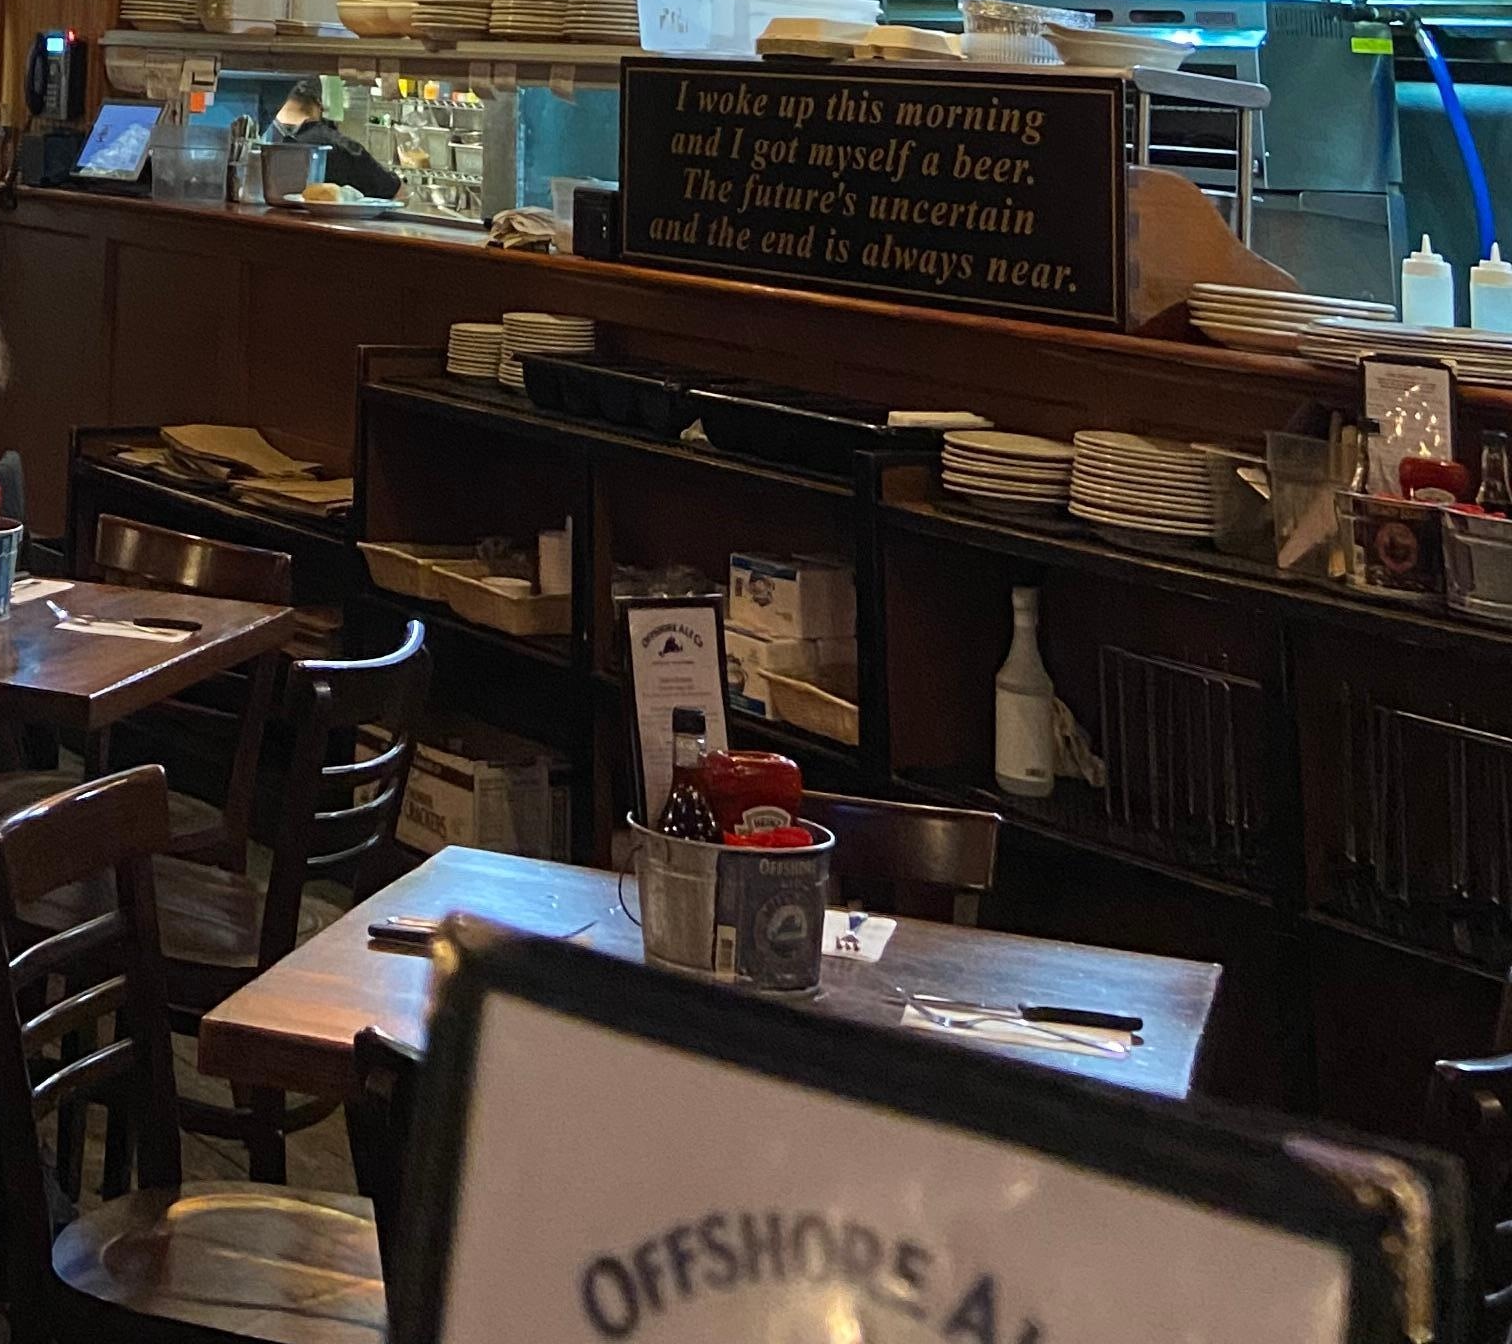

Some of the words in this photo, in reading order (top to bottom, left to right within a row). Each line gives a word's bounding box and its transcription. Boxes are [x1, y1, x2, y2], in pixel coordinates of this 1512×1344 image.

[675, 80, 689, 112] I
[697, 83, 768, 118] woke
[778, 99, 815, 128] up
[825, 89, 885, 124] this
[894, 97, 1046, 145] morning
[670, 126, 720, 159] and
[729, 130, 744, 160] I
[751, 138, 800, 172] got
[808, 140, 916, 182] myself
[921, 154, 941, 178] a
[952, 145, 1037, 187] beer.
[683, 166, 734, 204] The
[738, 173, 859, 217] future's
[869, 192, 1037, 237] uncertain
[648, 212, 699, 247] and
[706, 218, 752, 252] the
[761, 226, 816, 261] end
[825, 227, 851, 264] is
[862, 234, 976, 286] always
[986, 256, 1078, 294] near.
[578, 1210, 934, 1342] OFFSHORE
